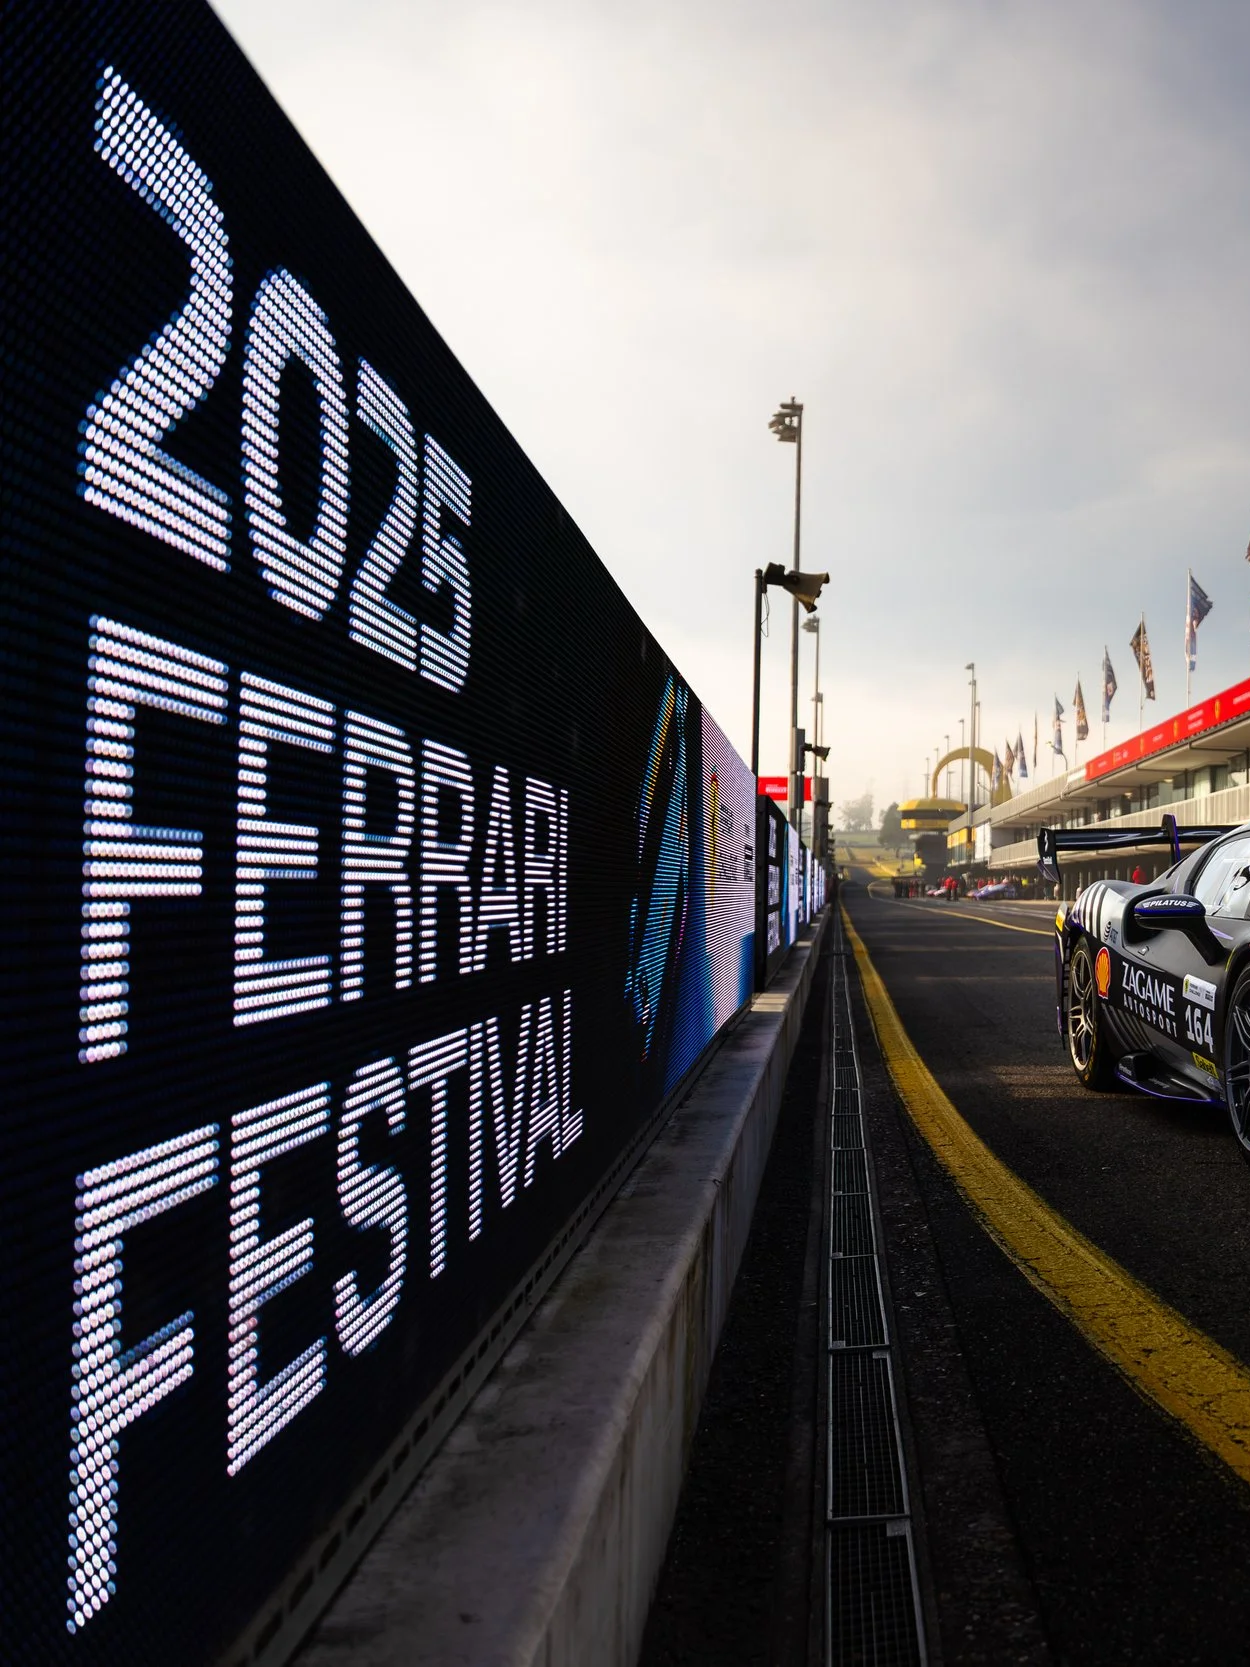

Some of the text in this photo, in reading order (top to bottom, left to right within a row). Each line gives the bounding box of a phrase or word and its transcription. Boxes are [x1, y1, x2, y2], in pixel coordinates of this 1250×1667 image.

[78, 62, 472, 694] 2025
[78, 614, 569, 1062] FERRARI
[1122, 961, 1175, 1016] ZAGAME
[1123, 993, 1177, 1037] AUTOSPORT
[1185, 1005, 1214, 1053] 164
[65, 988, 584, 1635] FESTIVAL
